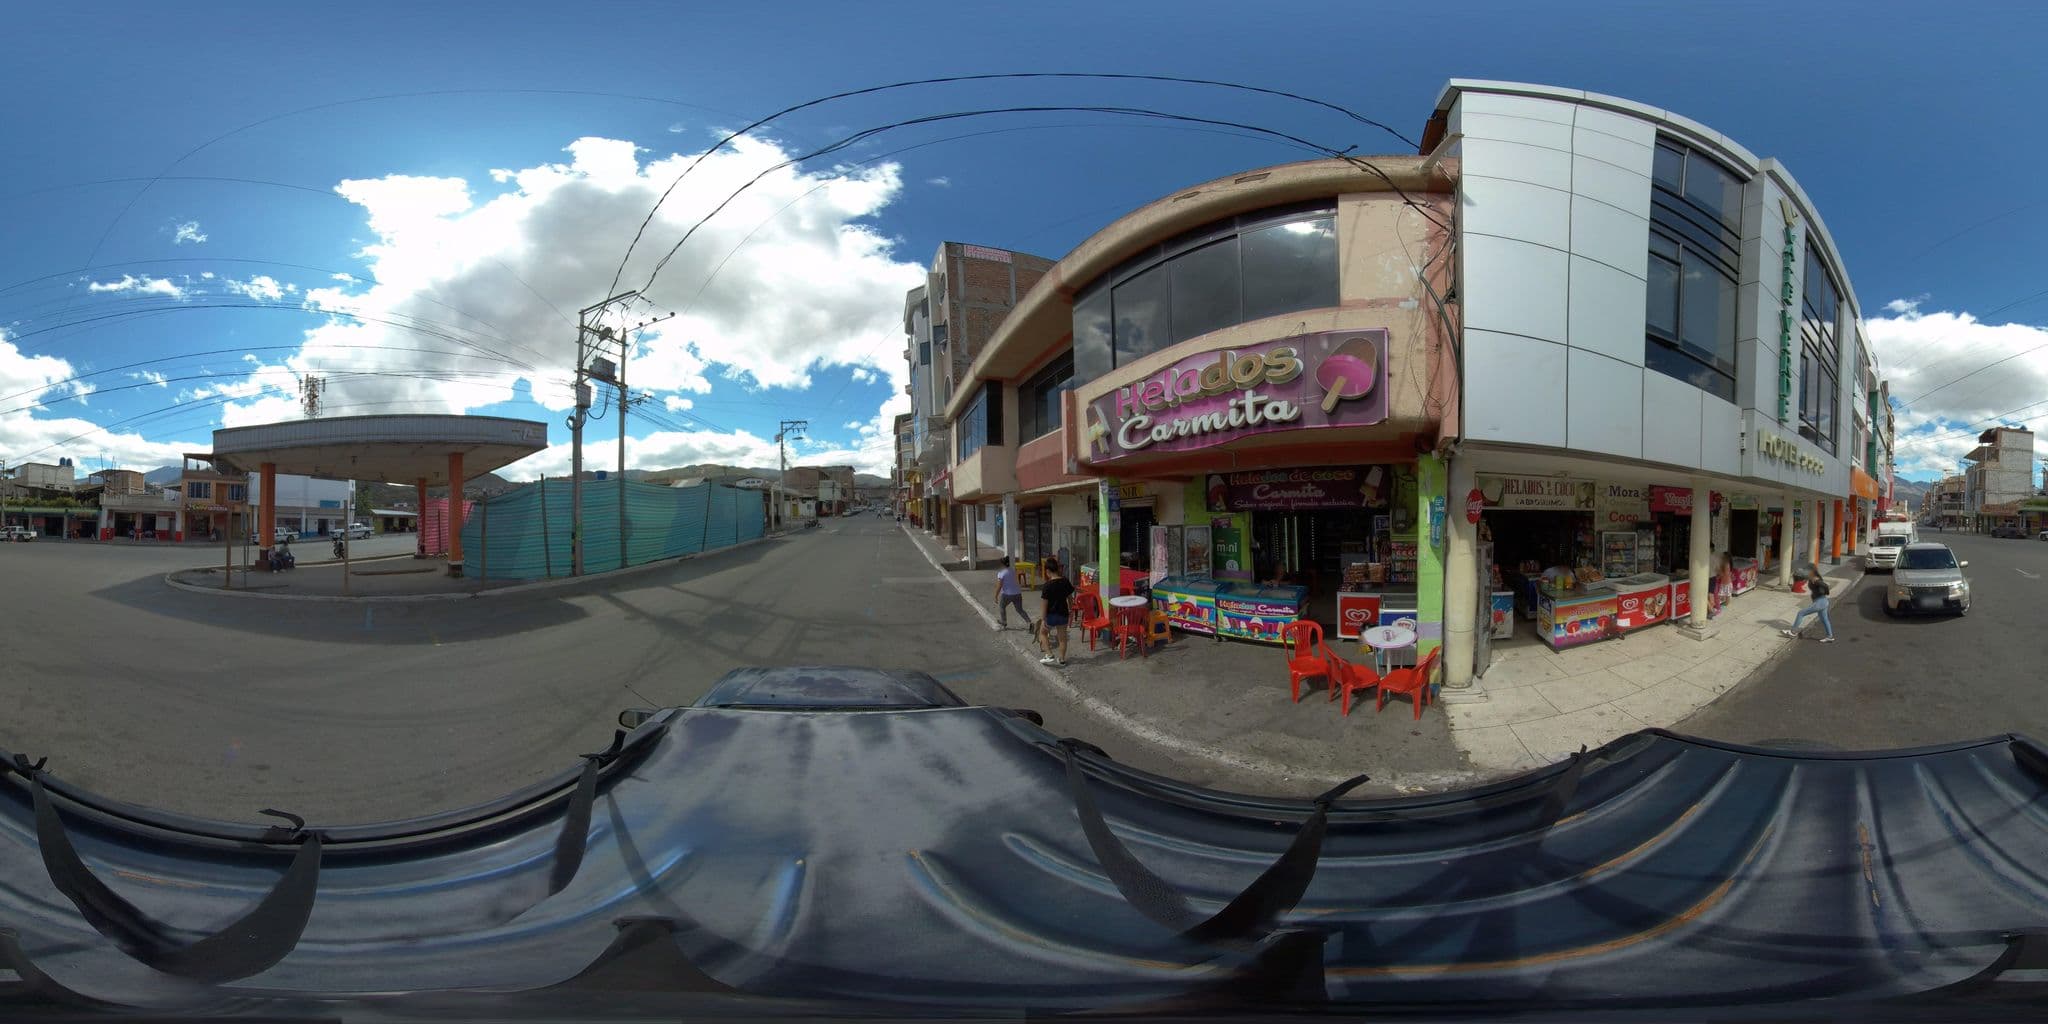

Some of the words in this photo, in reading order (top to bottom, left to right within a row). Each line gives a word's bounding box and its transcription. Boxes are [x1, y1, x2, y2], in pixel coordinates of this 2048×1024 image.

[1115, 346, 1304, 421] Helados
[1778, 310, 1792, 422] VERDE
[1118, 389, 1300, 450] Carmita
[1757, 429, 1800, 467] HOTEL
[1504, 478, 1544, 495] HELADOS
[1554, 480, 1575, 496] COCO
[1609, 485, 1639, 498] Mora
[1609, 511, 1640, 523] Coco
